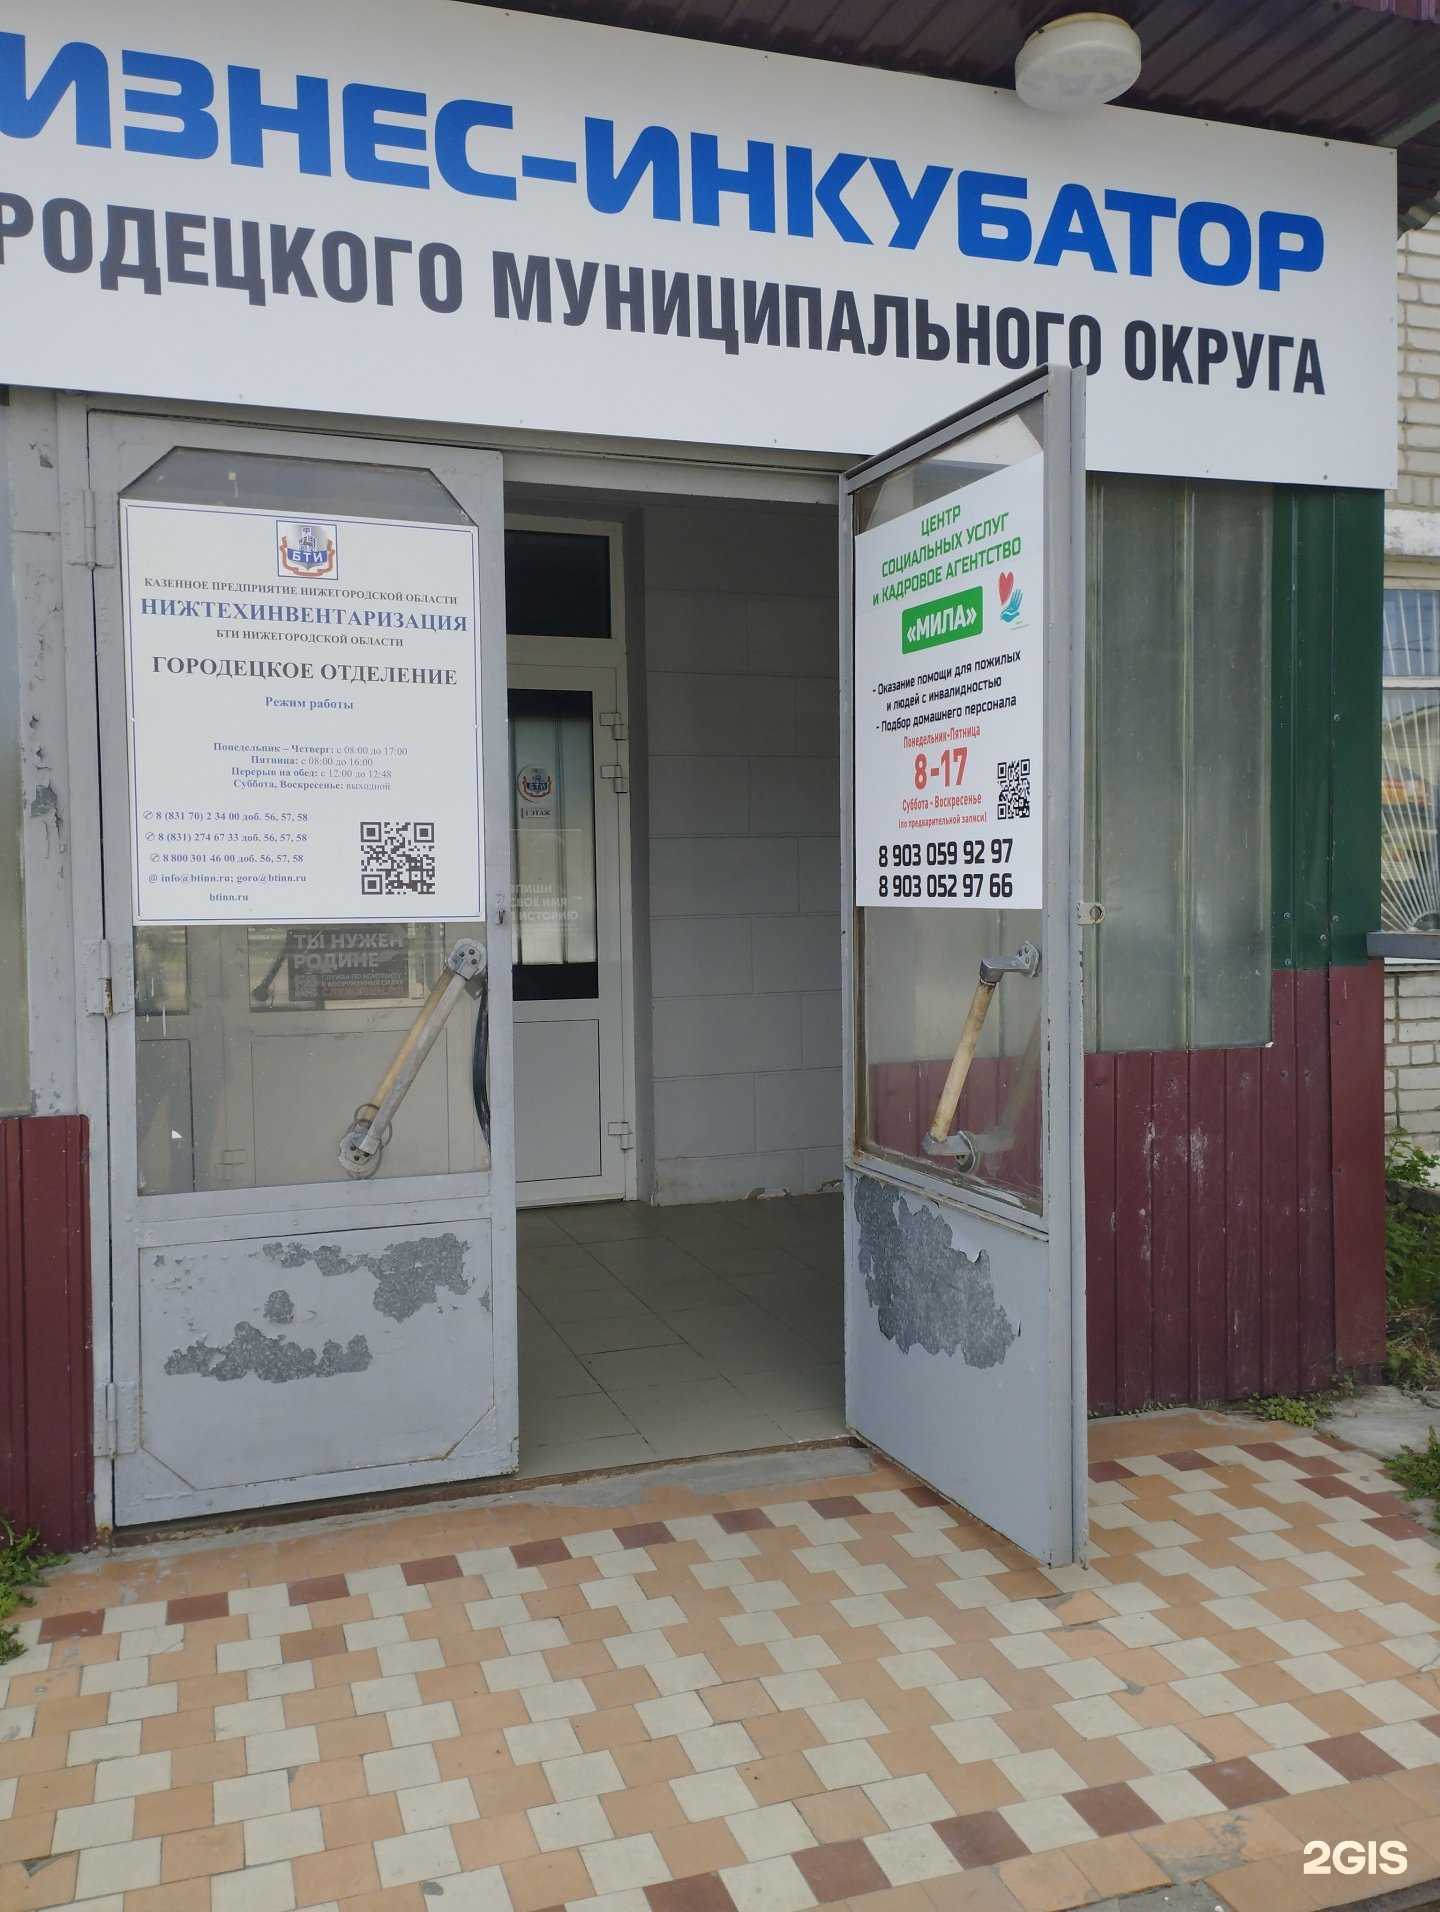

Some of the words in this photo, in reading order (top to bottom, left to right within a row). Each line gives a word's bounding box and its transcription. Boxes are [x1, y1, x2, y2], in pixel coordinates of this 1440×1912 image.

[493, 250, 1101, 376] МУНИЦИПАЛЬНОГО
[1126, 320, 1326, 396] ОКРУГА
[921, 505, 960, 536] ЦЕНТР
[882, 531, 963, 577] СОЦИАЛЬНЫХ
[966, 512, 1009, 544] УСЛУГ
[292, 551, 323, 563] БТИ
[873, 596, 879, 606] и
[882, 566, 942, 603] КАДРОВОЕ
[946, 536, 1021, 580] АГЕНТСТВО
[144, 578, 209, 590] КАЗЕННОЕ
[212, 582, 298, 595] ПРЕДПРИЯТИЕ
[300, 587, 403, 601] НИЖЕГОРОДСКОЙ
[406, 594, 457, 605] ОБЛАСТИ
[141, 598, 468, 632] НИЖТЕХИНВЕНТАРИЗАЦИЯ
[907, 605, 976, 643] «МИЛА»
[216, 629, 240, 639] БТИ
[243, 631, 348, 645] НИЖЕГОРОДСКОЙ
[351, 636, 404, 647] ОБЛАСТИ
[152, 656, 314, 679] ГОРОДЕЦКОЕ
[321, 664, 457, 685] ОТДЕЛЕНИЕ
[878, 678, 915, 695] Оказание
[918, 669, 951, 686] помощи
[955, 663, 972, 678] для
[975, 650, 1021, 671] пожилых
[265, 696, 306, 708] Режим
[310, 699, 353, 711] работы
[887, 702, 891, 711] и
[894, 693, 920, 709] людей
[922, 694, 926, 703] с
[929, 677, 1002, 701] инвалидностью
[881, 717, 911, 732] Подбор
[913, 707, 962, 728] домашнего
[965, 695, 1017, 716] персонала
[213, 742, 280, 753] Понедельник
[251, 755, 298, 765] Пятница:
[308, 757, 333, 766] 08:00
[915, 747, 968, 790] 8-17
[232, 767, 277, 777] Перерыв
[294, 768, 318, 777] обед:
[280, 780, 344, 791] Воскресенье:
[346, 783, 391, 791] выходной
[902, 799, 928, 813] Суббота
[935, 794, 982, 809] Воскресенье
[156, 811, 162, 819] 8
[206, 812, 212, 820] 2
[214, 812, 225, 820] 34
[229, 812, 239, 821] 00
[298, 813, 308, 822] 58
[909, 814, 960, 829] предварительной
[158, 833, 164, 841] 8
[167, 832, 191, 843] (831)
[195, 833, 211, 841] 274
[214, 833, 225, 841] 67
[228, 833, 239, 841] 33
[296, 834, 307, 842] 58
[163, 854, 168, 862] 8
[171, 854, 188, 862] 800
[191, 854, 207, 862] 301
[210, 854, 221, 862] 46
[293, 855, 304, 863] 58
[879, 845, 888, 867] 8
[893, 844, 920, 866] 903
[927, 842, 957, 865] 059
[964, 840, 984, 864] 92
[991, 838, 1013, 863] 97
[879, 876, 888, 897] 8
[893, 875, 921, 897] 903
[927, 874, 957, 897] 052
[963, 874, 983, 897] 97
[990, 873, 1013, 897] 66
[210, 893, 248, 902] btinn.ru
[294, 934, 325, 949] ТЫ
[331, 933, 404, 948] НУЖЕН
